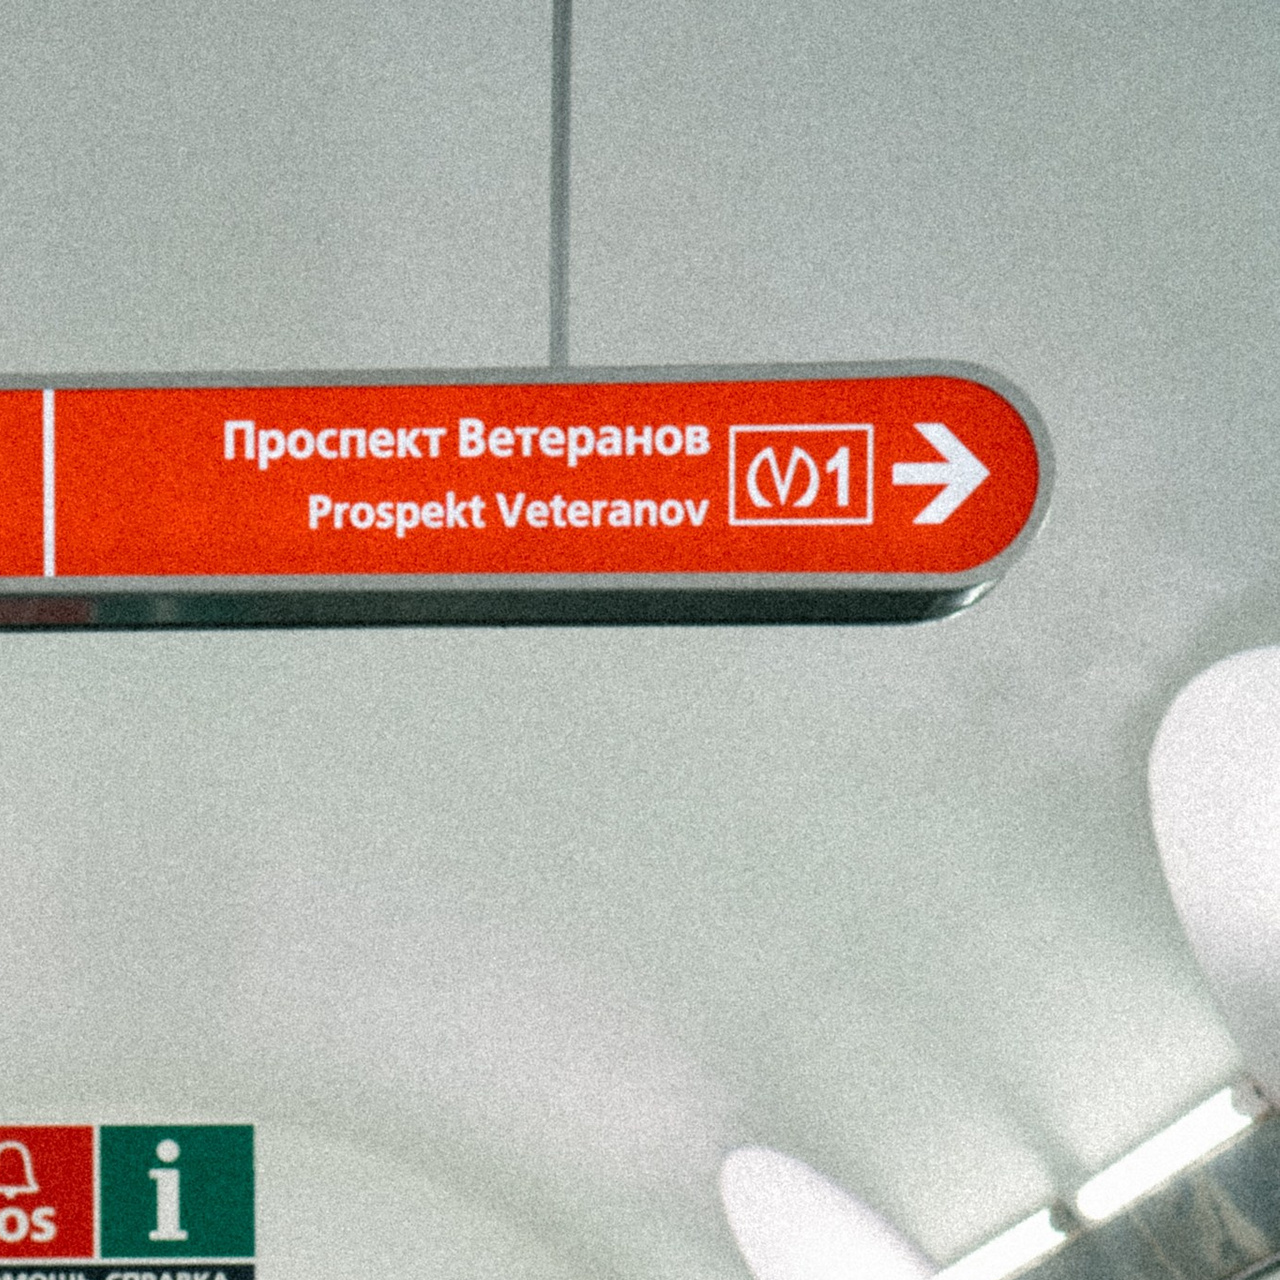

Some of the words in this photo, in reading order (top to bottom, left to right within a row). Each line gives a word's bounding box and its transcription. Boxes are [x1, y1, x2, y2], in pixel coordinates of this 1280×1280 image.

[224, 419, 447, 471] Проспект
[458, 417, 711, 466] Ветеранов
[308, 491, 486, 539] Prospekt
[495, 492, 710, 529] Veteranov
